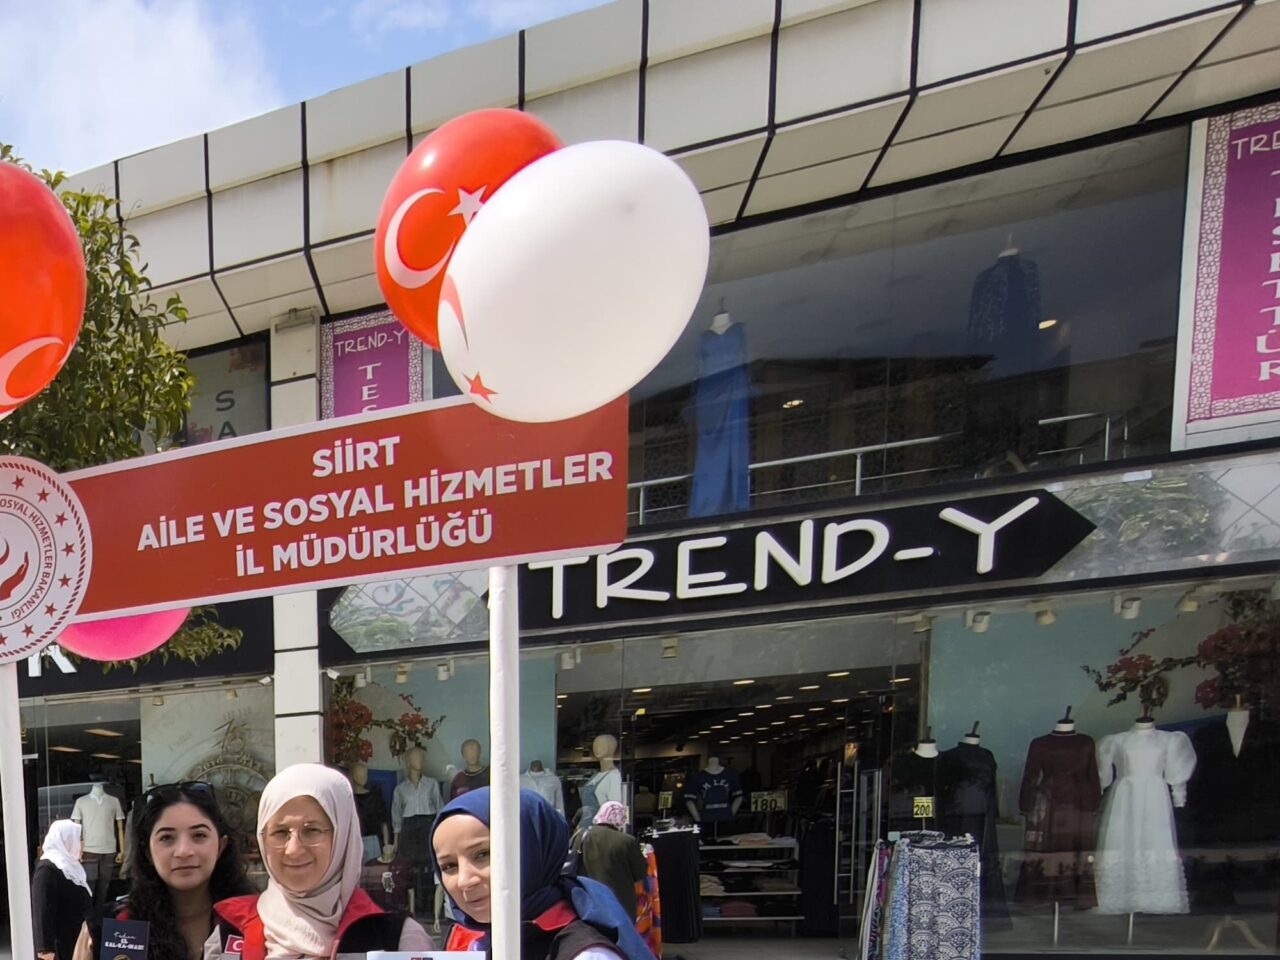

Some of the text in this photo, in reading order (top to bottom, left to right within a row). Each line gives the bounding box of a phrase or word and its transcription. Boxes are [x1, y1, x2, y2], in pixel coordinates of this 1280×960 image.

[335, 328, 407, 357] TREND-Y
[312, 436, 400, 478] SİİRT
[137, 451, 613, 551] AİLE VE SOSYAL HİZMETLER
[29, 511, 53, 569] HİZMETLER
[235, 508, 493, 577] İL MÜDÜRLÜĞÜ
[528, 497, 1039, 619] TREND-Y
[11, 569, 52, 620] BAKANLIĞI
[752, 798, 777, 812] 180
[914, 804, 931, 816] 200
